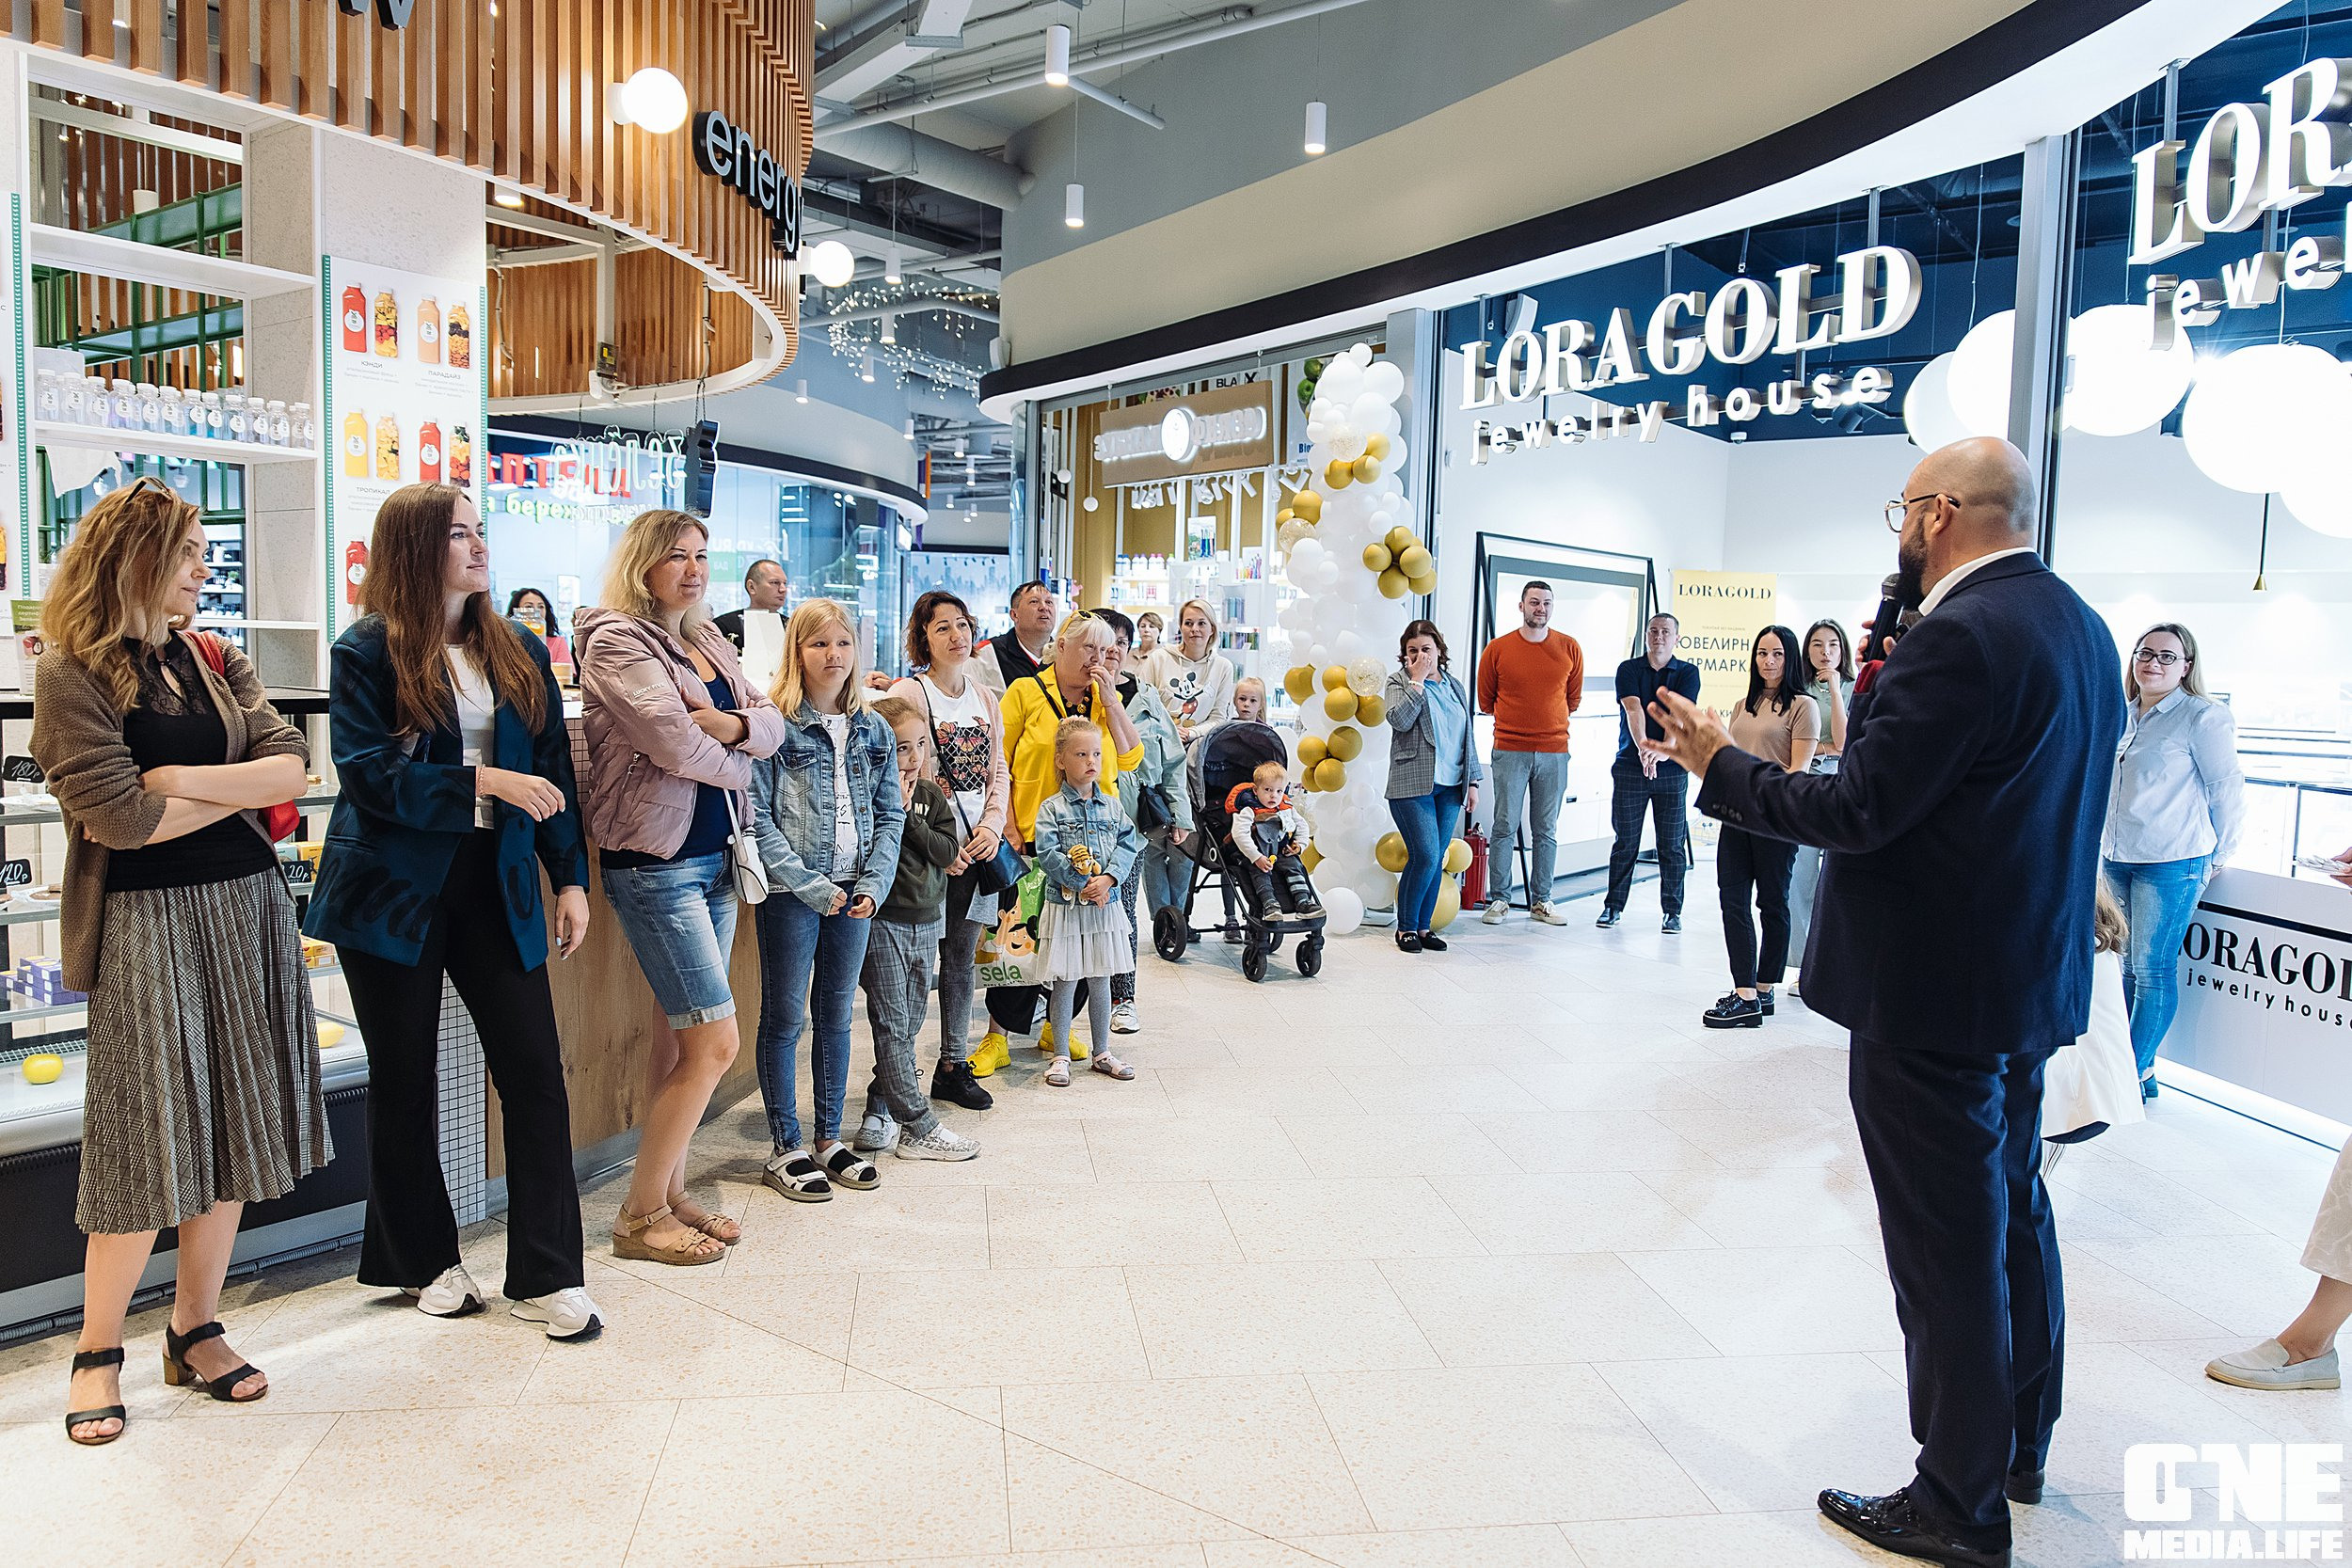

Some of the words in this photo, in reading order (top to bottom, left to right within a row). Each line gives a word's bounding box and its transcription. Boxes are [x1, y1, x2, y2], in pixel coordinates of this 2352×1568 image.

[2127, 57, 2352, 264] LOR
[692, 111, 804, 261] energ
[1459, 245, 1922, 410] LORAGOLD
[1470, 400, 1670, 466] jewelry
[1687, 367, 1894, 427] house
[1298, 442, 1314, 453] Bio
[1678, 583, 1772, 600] LORAGOLD
[1676, 636, 1750, 651] ЮВЕЛИРН
[1687, 657, 1750, 672] ЯРМАРК
[632, 686, 651, 697] LUCKY
[980, 960, 1023, 981] sela
[2178, 922, 2352, 1002] ORAGOL
[2186, 968, 2275, 1009] jewelry
[2284, 994, 2352, 1030] hous
